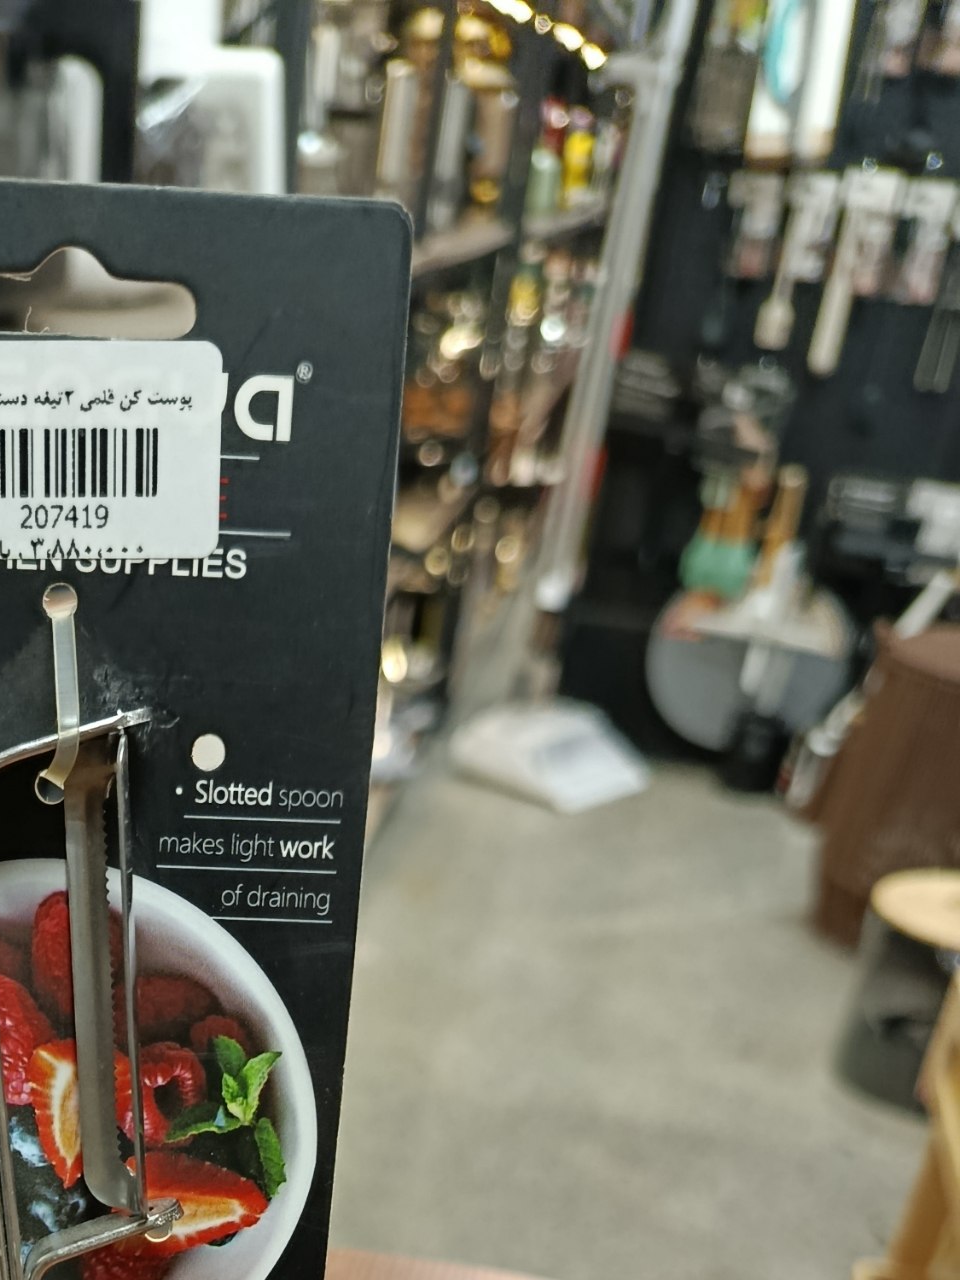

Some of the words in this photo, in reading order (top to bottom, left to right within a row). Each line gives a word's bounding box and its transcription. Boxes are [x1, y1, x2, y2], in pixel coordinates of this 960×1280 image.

[119, 389, 142, 412] کن
[147, 391, 192, 411] پوست
[20, 504, 109, 530] 207419
[194, 779, 273, 806] Slotted
[278, 788, 344, 812] spoon
[158, 832, 225, 856] makes
[231, 833, 274, 863] light
[279, 835, 335, 860] work
[220, 883, 244, 907] of
[246, 885, 331, 916] draining
